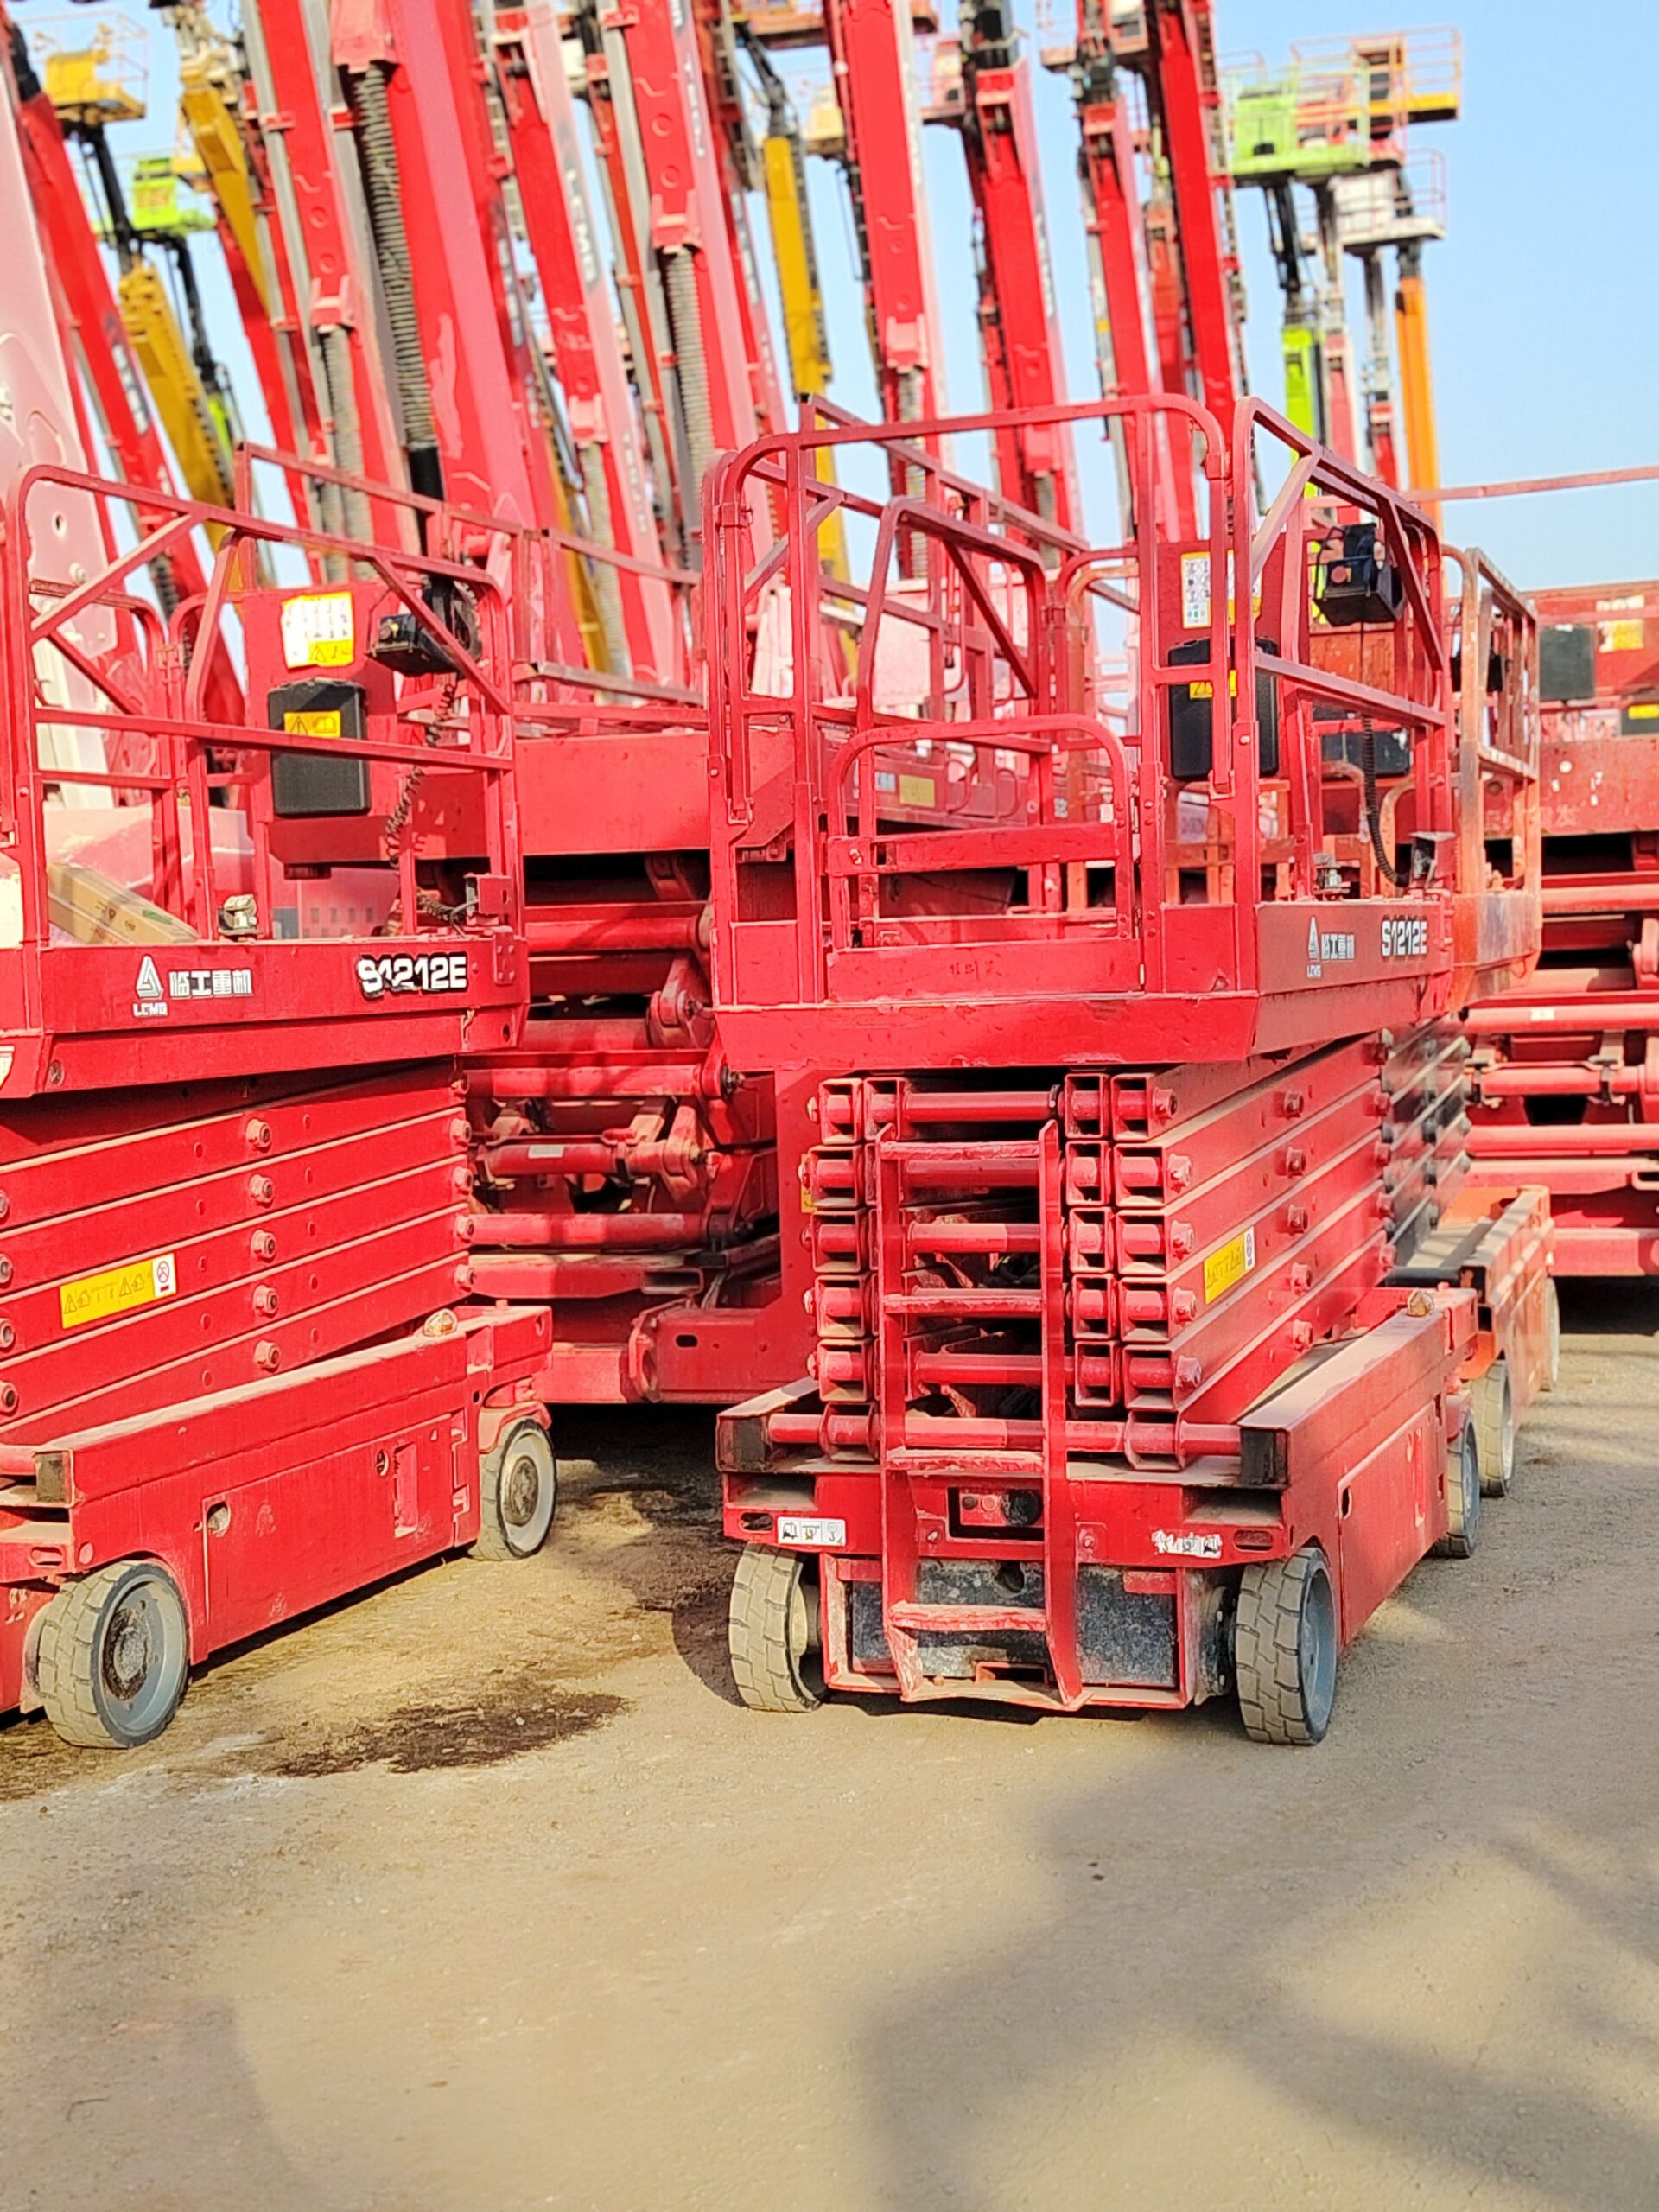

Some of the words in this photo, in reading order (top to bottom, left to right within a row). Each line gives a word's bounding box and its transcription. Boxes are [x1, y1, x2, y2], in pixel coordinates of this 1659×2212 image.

[1382, 918, 1428, 957] S1212E
[168, 969, 253, 998] 临工重机
[357, 952, 468, 995] S1212E
